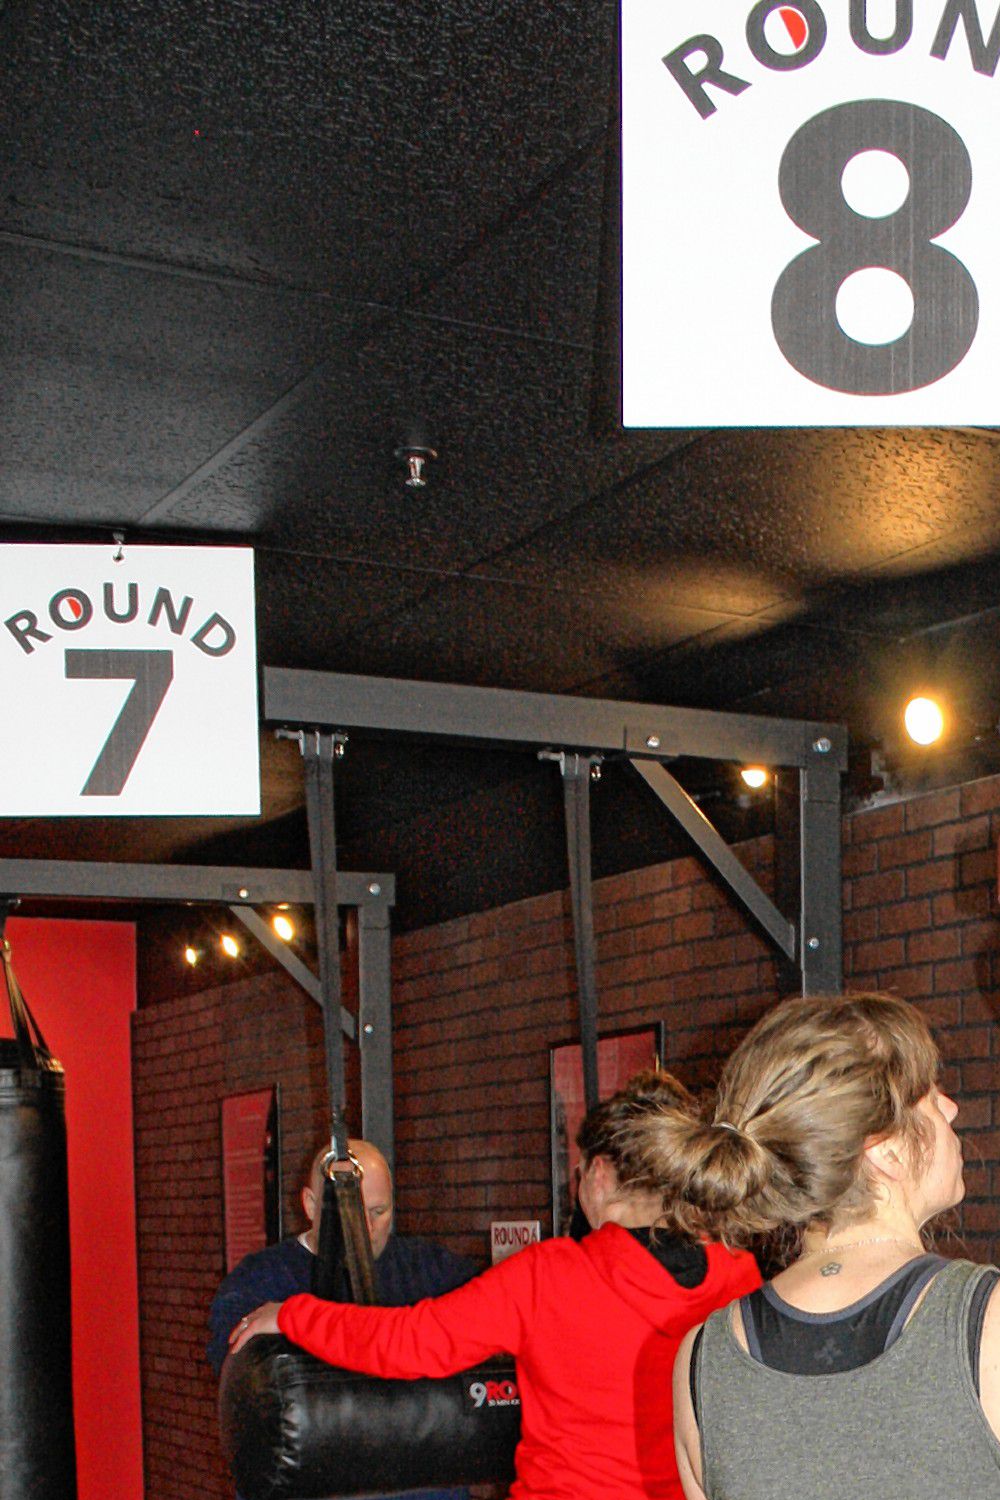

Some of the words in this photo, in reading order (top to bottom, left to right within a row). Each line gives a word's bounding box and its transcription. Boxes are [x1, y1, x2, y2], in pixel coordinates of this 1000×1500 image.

[770, 98, 980, 397] 8
[4, 582, 237, 658] ROUND
[63, 648, 174, 796] 7
[494, 1227, 530, 1245] ROUND
